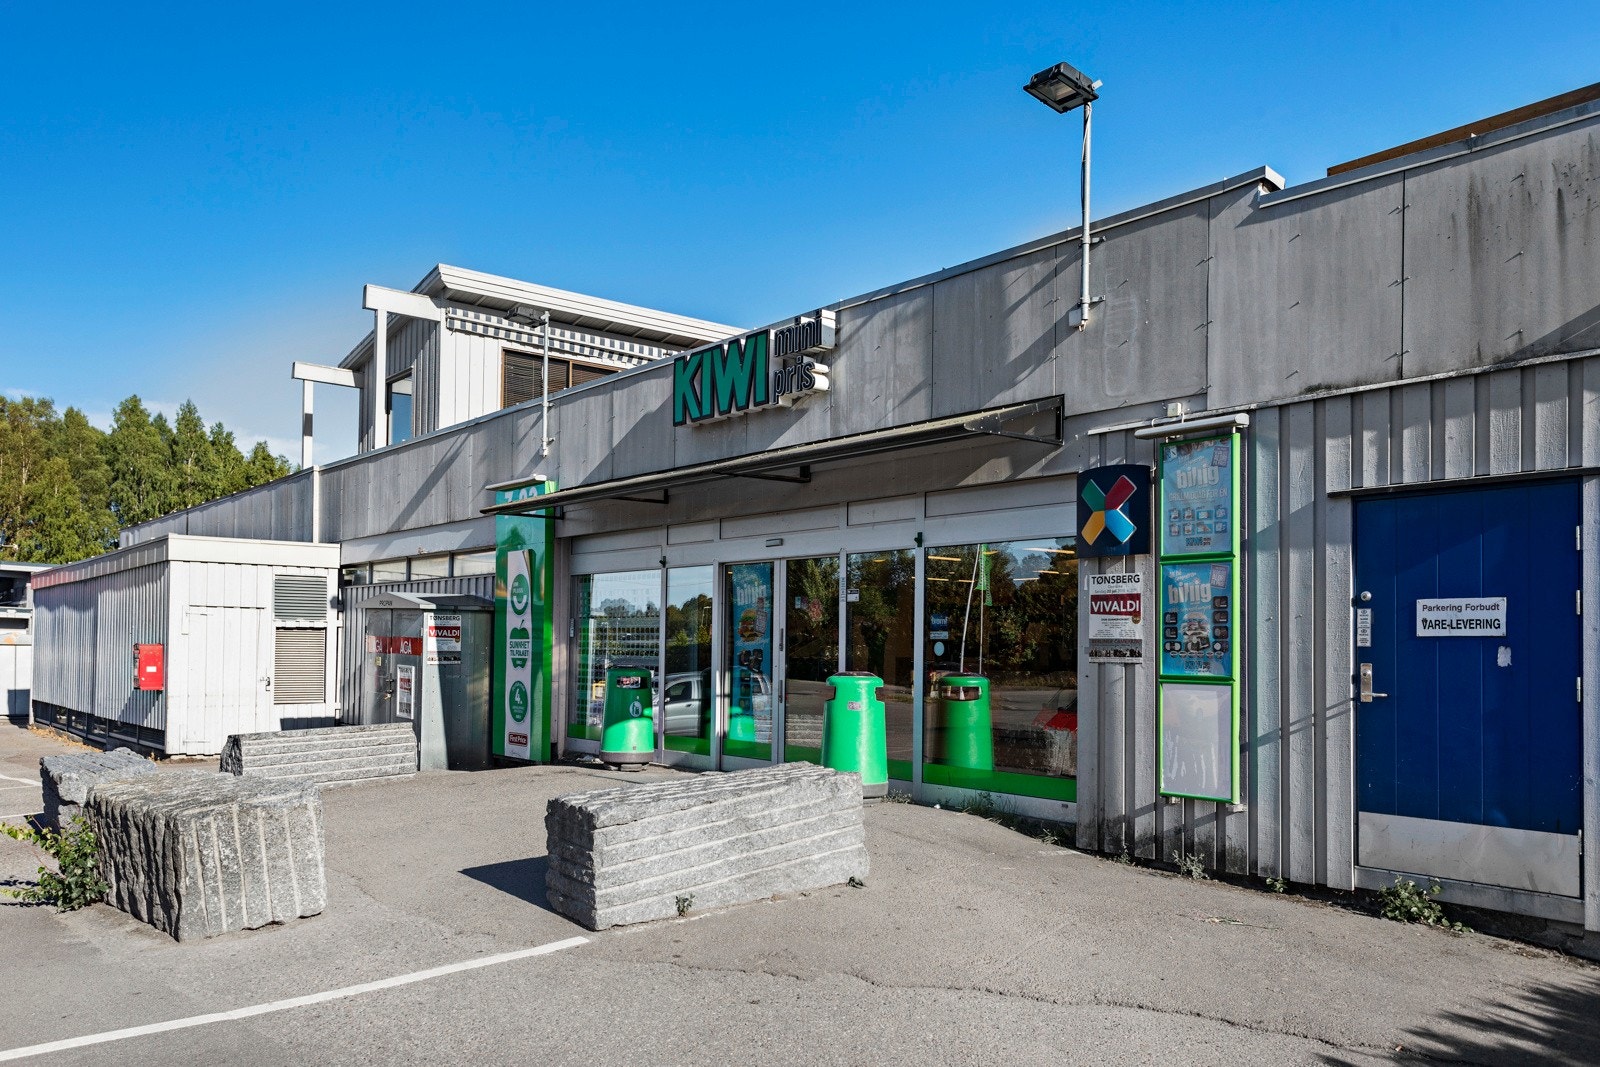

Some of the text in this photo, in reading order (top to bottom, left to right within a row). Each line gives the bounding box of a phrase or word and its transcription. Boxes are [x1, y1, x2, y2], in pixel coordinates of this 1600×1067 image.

[775, 309, 822, 357] mini
[673, 329, 770, 427] KIWI
[773, 356, 815, 404] pris
[1176, 465, 1219, 489] billig
[1091, 575, 1140, 584] TØNSBERG
[1168, 580, 1212, 605] billig
[1092, 601, 1140, 612] VIVALDI
[1422, 602, 1500, 613] Parkering Forbudt
[1422, 618, 1501, 630] VARE-LEVERING
[429, 629, 460, 637] VIVALDI
[400, 641, 412, 655] AGA
